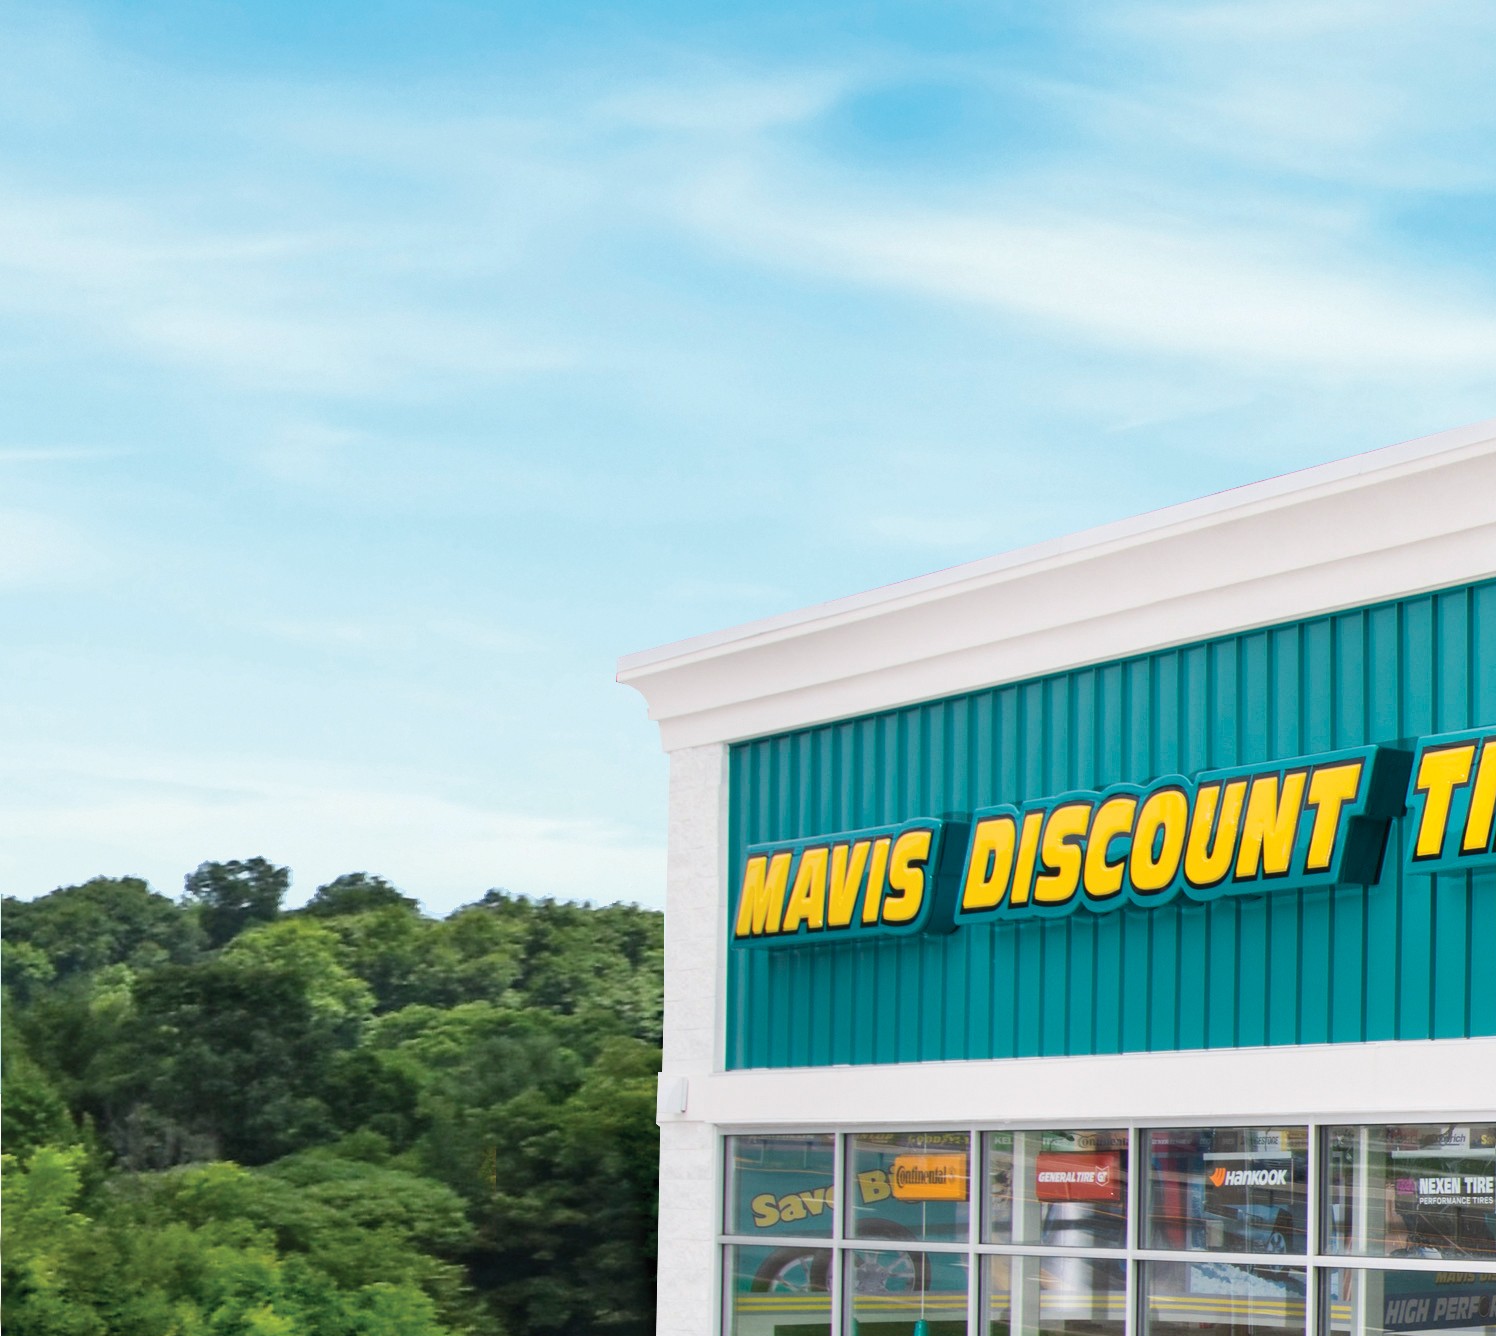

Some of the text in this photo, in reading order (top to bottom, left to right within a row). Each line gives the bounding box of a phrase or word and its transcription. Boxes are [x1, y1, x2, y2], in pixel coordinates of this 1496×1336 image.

[734, 831, 932, 940] MAVIS
[960, 755, 1367, 914] DISCOUNT
[895, 1164, 947, 1189] Continental
[1418, 1177, 1461, 1195] NEXEN
[1463, 1176, 1494, 1194] TIRE
[1419, 1196, 1494, 1205] PERFORMANCE TIRES
[1385, 1298, 1430, 1325] HIGH
